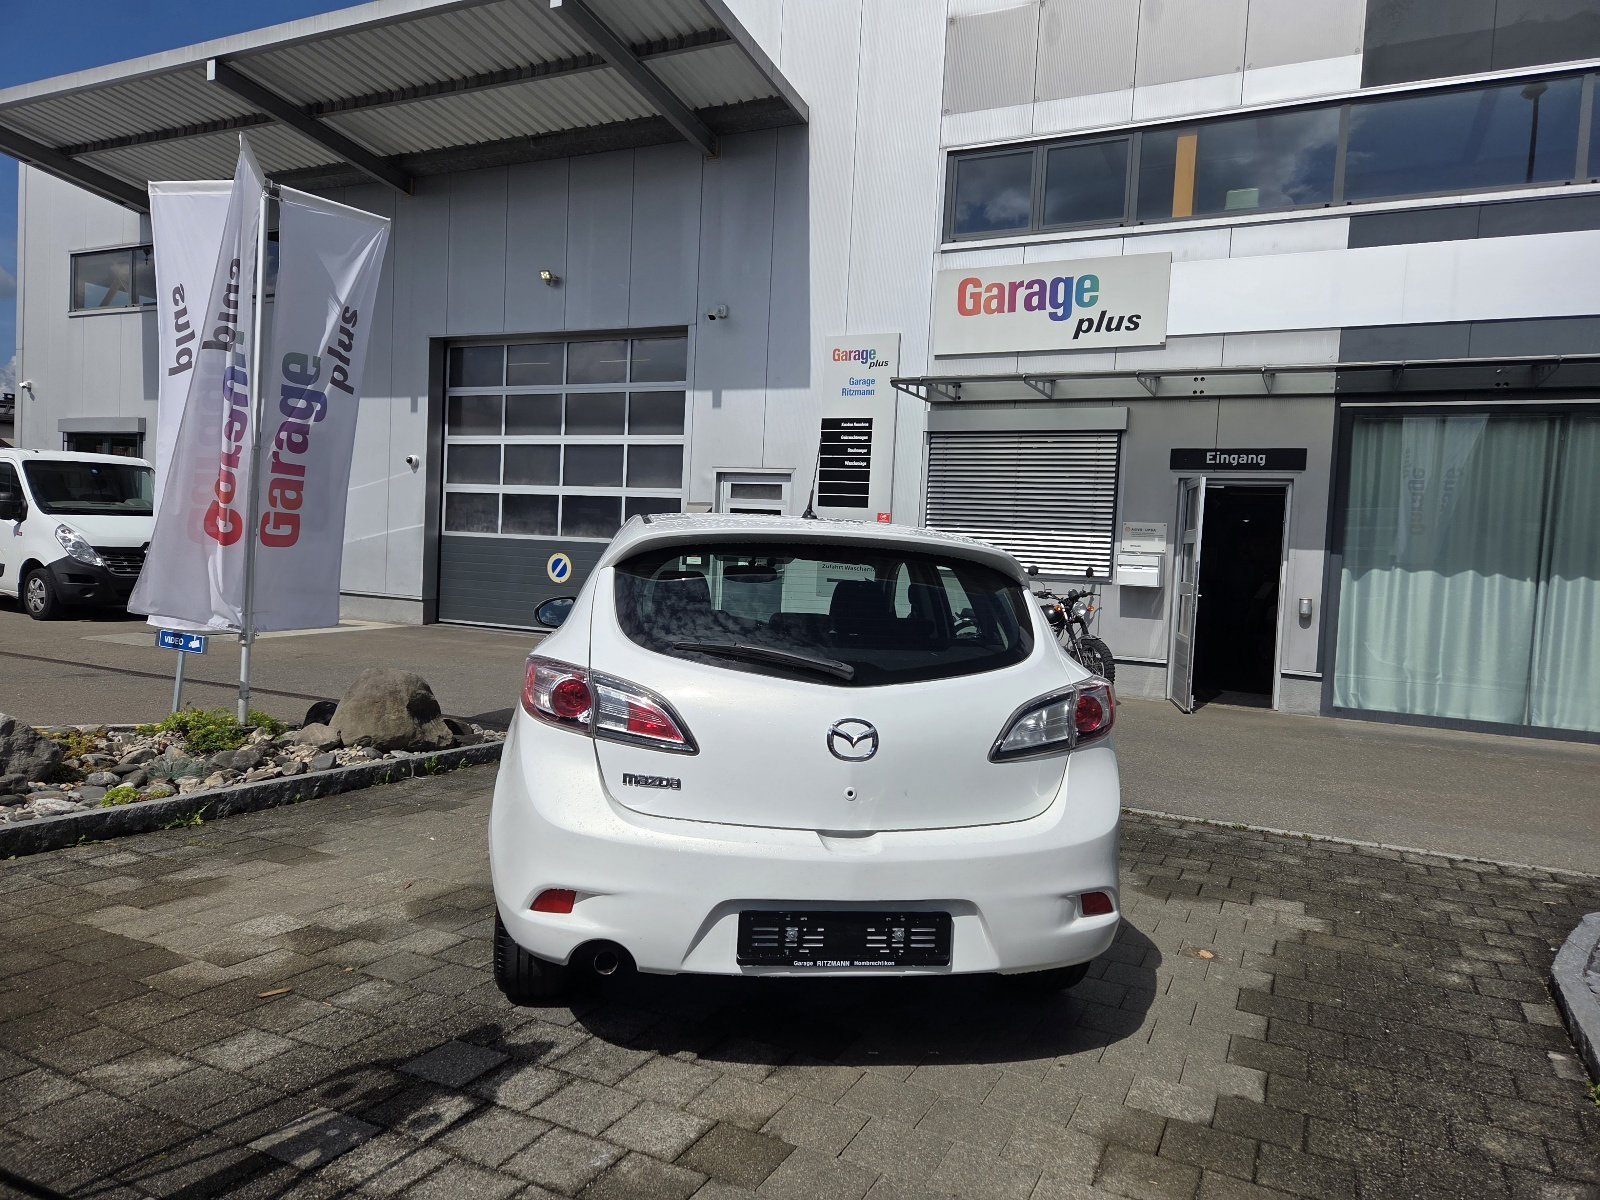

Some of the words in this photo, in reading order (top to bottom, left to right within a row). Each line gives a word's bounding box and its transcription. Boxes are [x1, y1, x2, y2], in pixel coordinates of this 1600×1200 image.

[957, 273, 1099, 322] Garage
[1072, 310, 1142, 340] plus
[329, 304, 360, 395] plus
[832, 348, 876, 364] Garage
[868, 358, 889, 369] plus
[849, 377, 876, 387] Garage
[841, 387, 876, 397] Ritzmann
[261, 351, 328, 549] Garage
[1206, 451, 1267, 467] Eingang
[821, 563, 844, 571] Zufahrt
[164, 635, 184, 646] VIDEO
